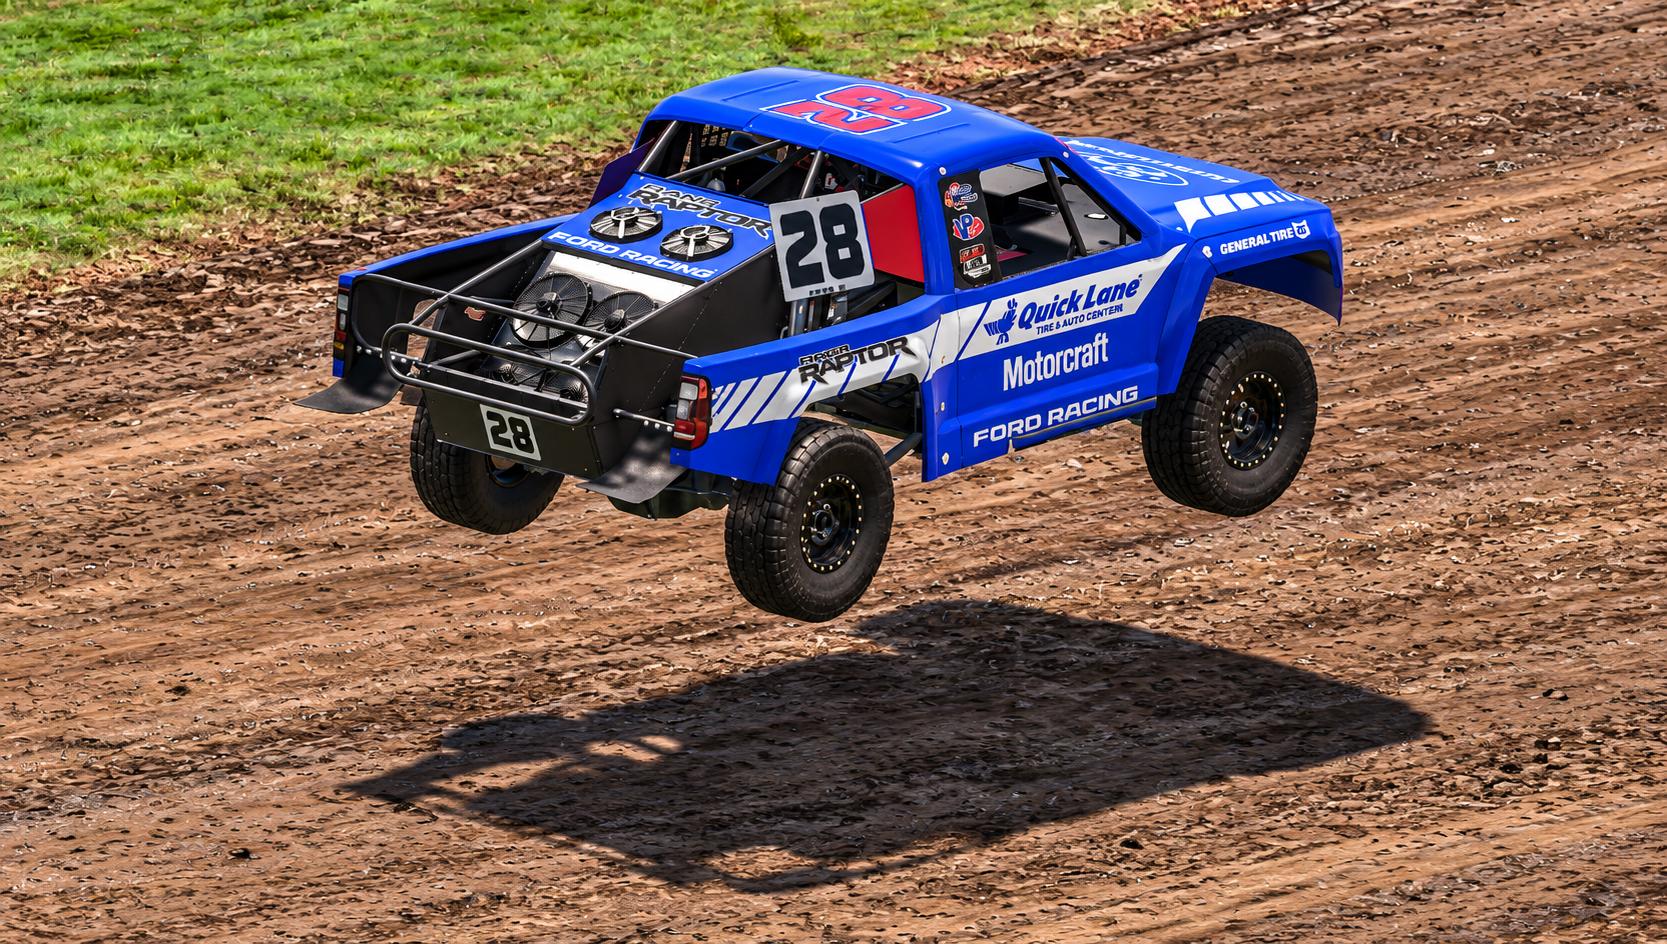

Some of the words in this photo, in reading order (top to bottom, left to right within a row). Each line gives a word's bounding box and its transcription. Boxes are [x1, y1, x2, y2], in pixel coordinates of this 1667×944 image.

[759, 83, 951, 136] 28
[627, 190, 772, 240] RAPTOR
[548, 231, 620, 254] FORD
[618, 249, 716, 279] RACING
[780, 203, 865, 289] 28
[1220, 233, 1270, 255] GENERAL
[1269, 227, 1294, 242] TIRE
[1018, 289, 1083, 330] Quick
[1082, 278, 1140, 310] Lane
[1036, 322, 1055, 335] TIRE
[1055, 320, 1061, 330] &
[1062, 313, 1085, 328] AUTO
[798, 336, 917, 385] RAPTOR
[1003, 332, 1109, 391] Motorcraft
[485, 410, 536, 454] 28
[973, 413, 1042, 448] FORD
[1047, 385, 1139, 426] RACING
